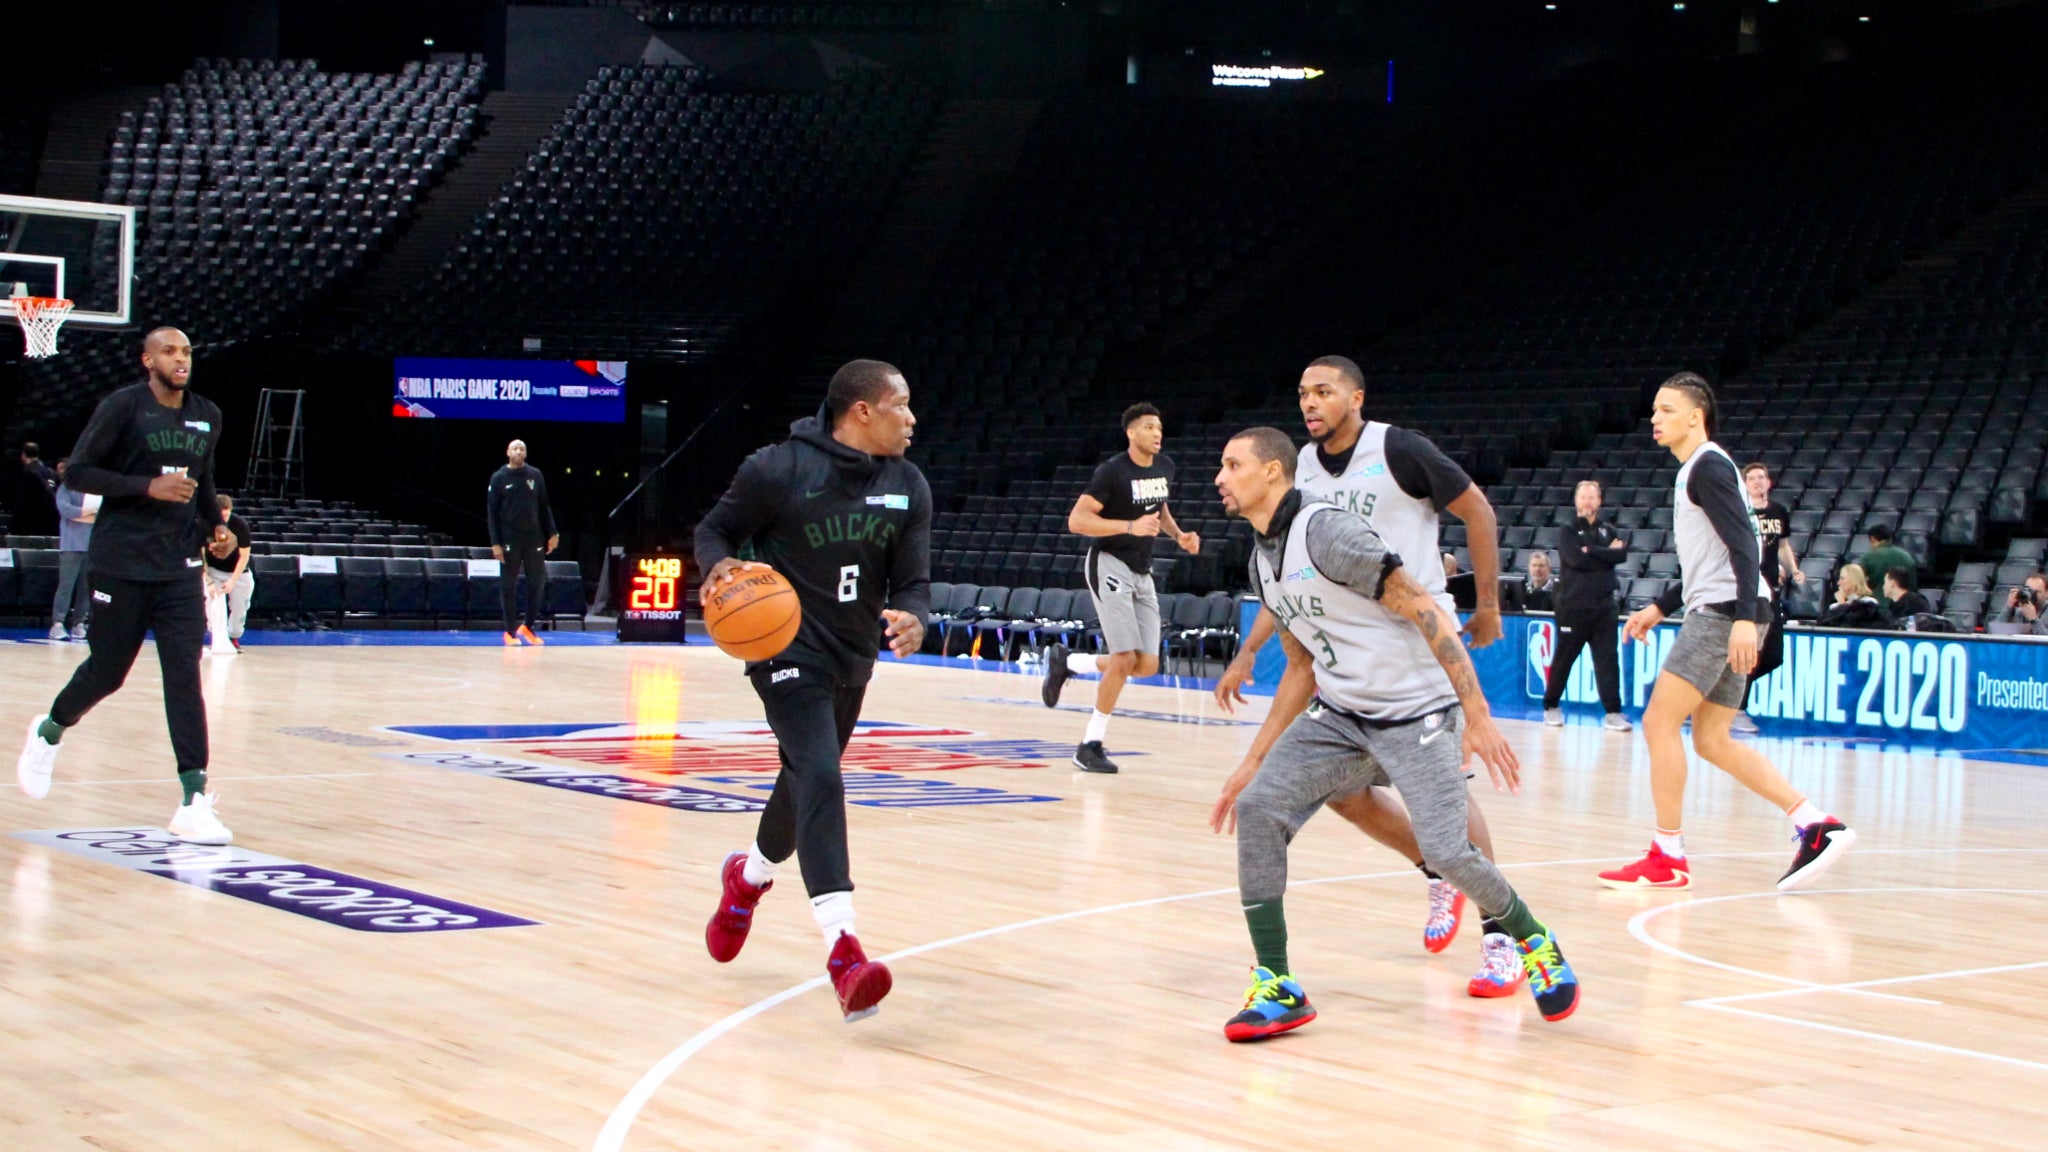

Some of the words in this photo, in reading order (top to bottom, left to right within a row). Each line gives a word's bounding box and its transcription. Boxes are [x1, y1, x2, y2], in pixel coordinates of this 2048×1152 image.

[409, 377, 431, 398] NBA
[433, 378, 467, 399] PARIS
[468, 379, 498, 400] GAME
[500, 380, 530, 401] 2020
[146, 430, 206, 457] BUCKS
[1324, 490, 1376, 517] CKS
[804, 513, 896, 548] BUCKS
[1760, 518, 1781, 534] CKS
[640, 558, 680, 578] 4:08
[632, 577, 675, 608] 20
[838, 564, 859, 602] 6
[641, 610, 681, 619] TISSOT
[1312, 631, 1337, 668] 3
[771, 668, 799, 684] BUCKS
[1856, 639, 1967, 732] 2020
[209, 870, 478, 928] SPORTS
